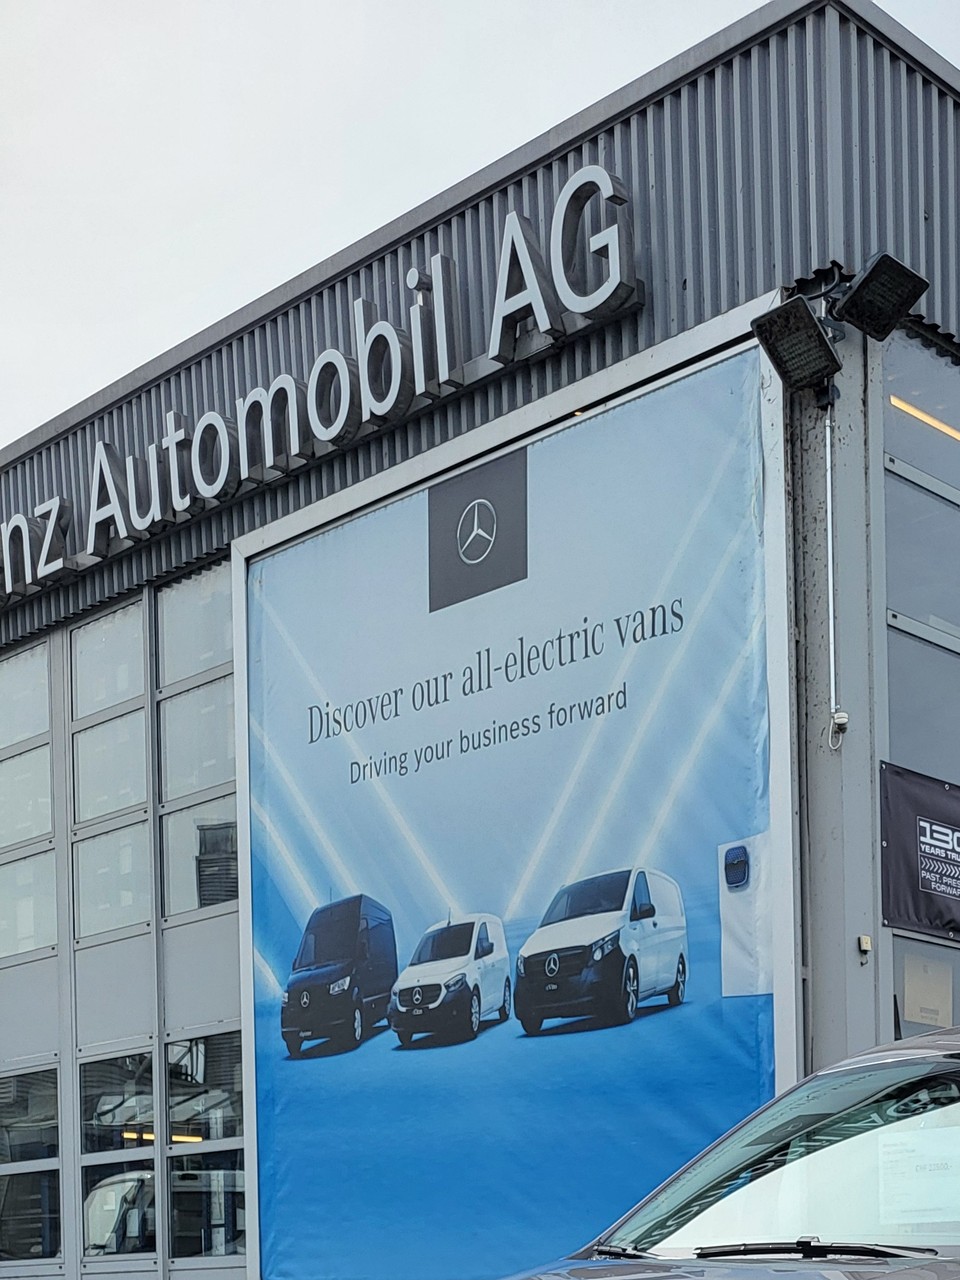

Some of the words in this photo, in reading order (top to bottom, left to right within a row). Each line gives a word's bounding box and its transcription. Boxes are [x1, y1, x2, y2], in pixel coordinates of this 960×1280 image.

[86, 252, 453, 558] Automobil
[488, 164, 626, 362] AG
[307, 685, 404, 745] Discover
[411, 671, 454, 712] our
[461, 616, 605, 698] all-electric
[613, 596, 685, 649] vans
[350, 749, 408, 785] Driving
[413, 734, 454, 774] your
[459, 711, 541, 756] business
[547, 681, 628, 731] forward
[919, 843, 946, 858] YEARS
[921, 870, 942, 883] PAST.
